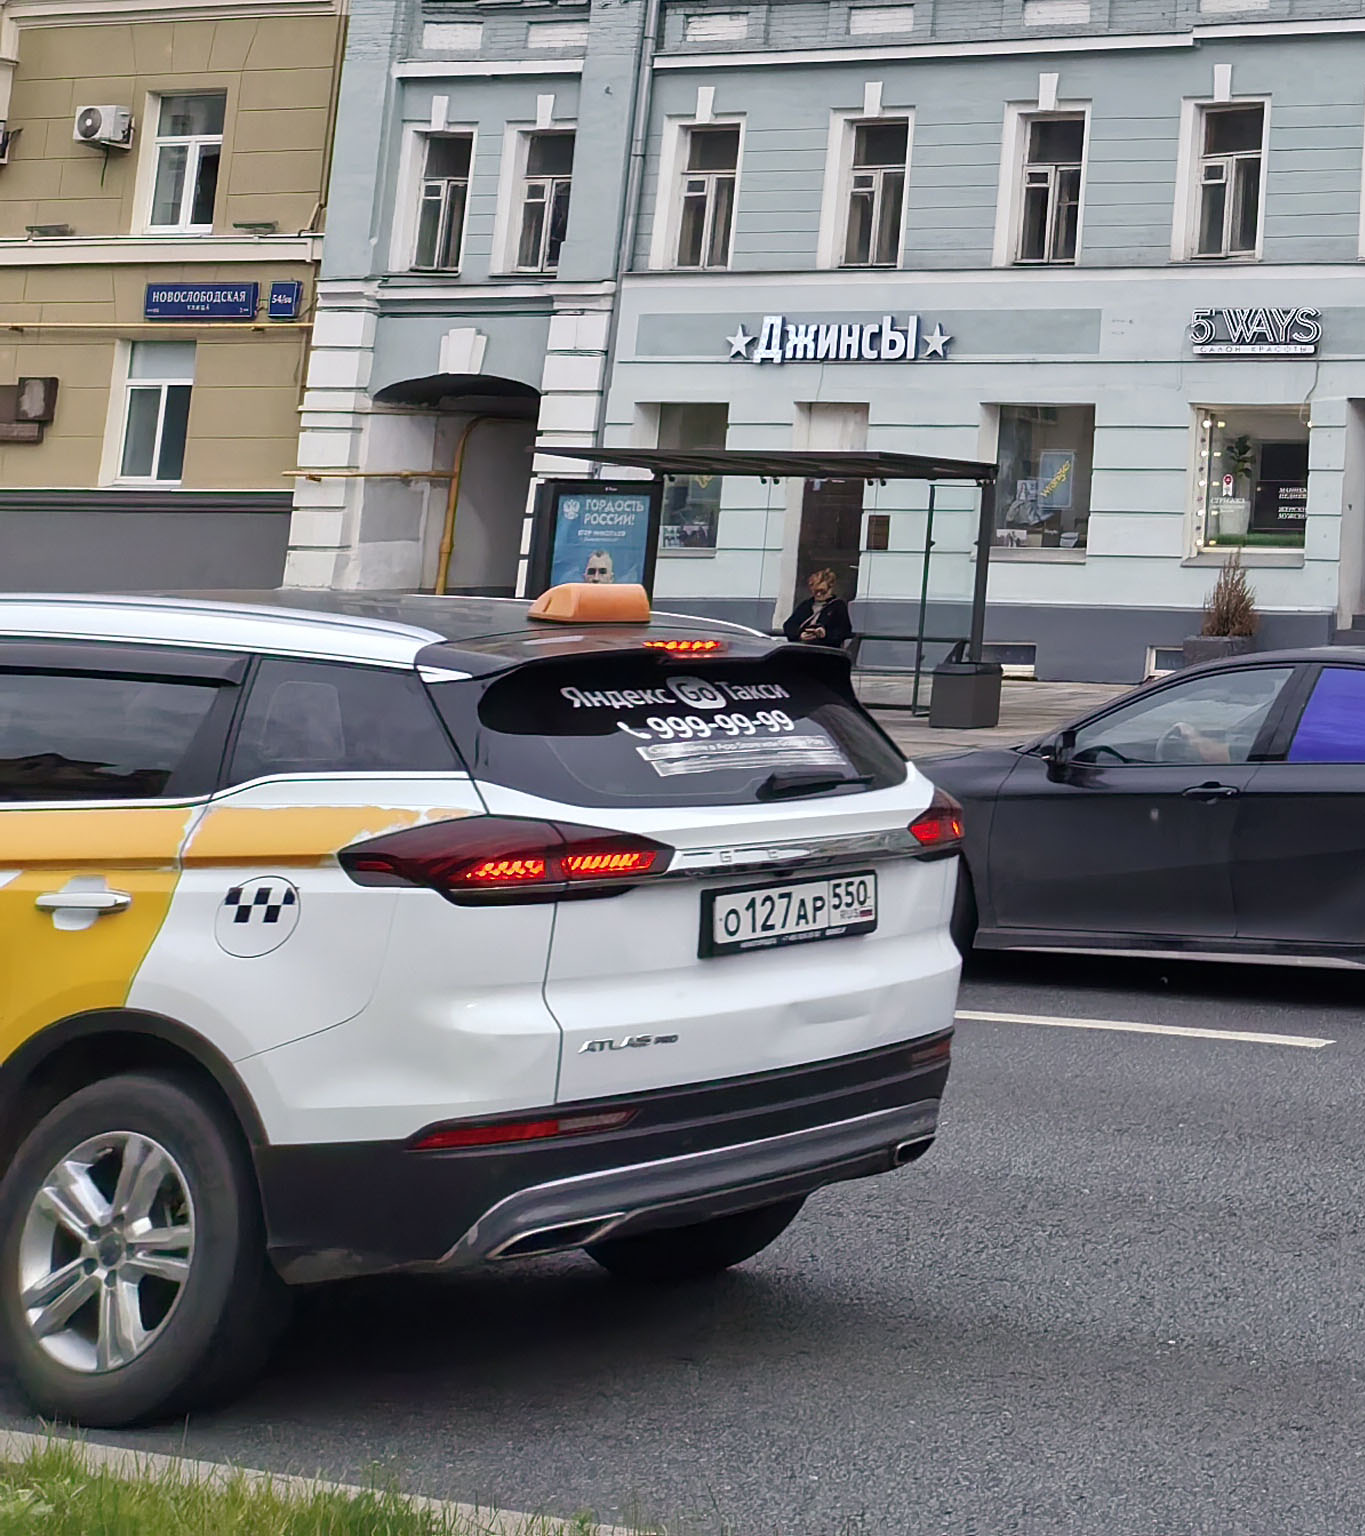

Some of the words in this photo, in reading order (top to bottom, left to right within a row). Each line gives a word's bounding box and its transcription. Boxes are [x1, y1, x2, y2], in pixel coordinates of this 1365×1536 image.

[152, 290, 246, 303] НОВОСЛОБОДСКАЯ
[1190, 308, 1215, 344] 5
[1222, 307, 1322, 344] WAYS
[1199, 344, 1241, 353] САЛОН
[585, 498, 645, 512] ГОРДОСТЬ
[583, 512, 636, 526] РОССИИ!
[560, 686, 677, 710] Яндекс
[715, 681, 791, 701] Такси
[647, 710, 795, 739] 999-99-99
[832, 879, 868, 910] 550
[839, 908, 859, 920] RUS
[577, 1033, 653, 1055] ATLAS
